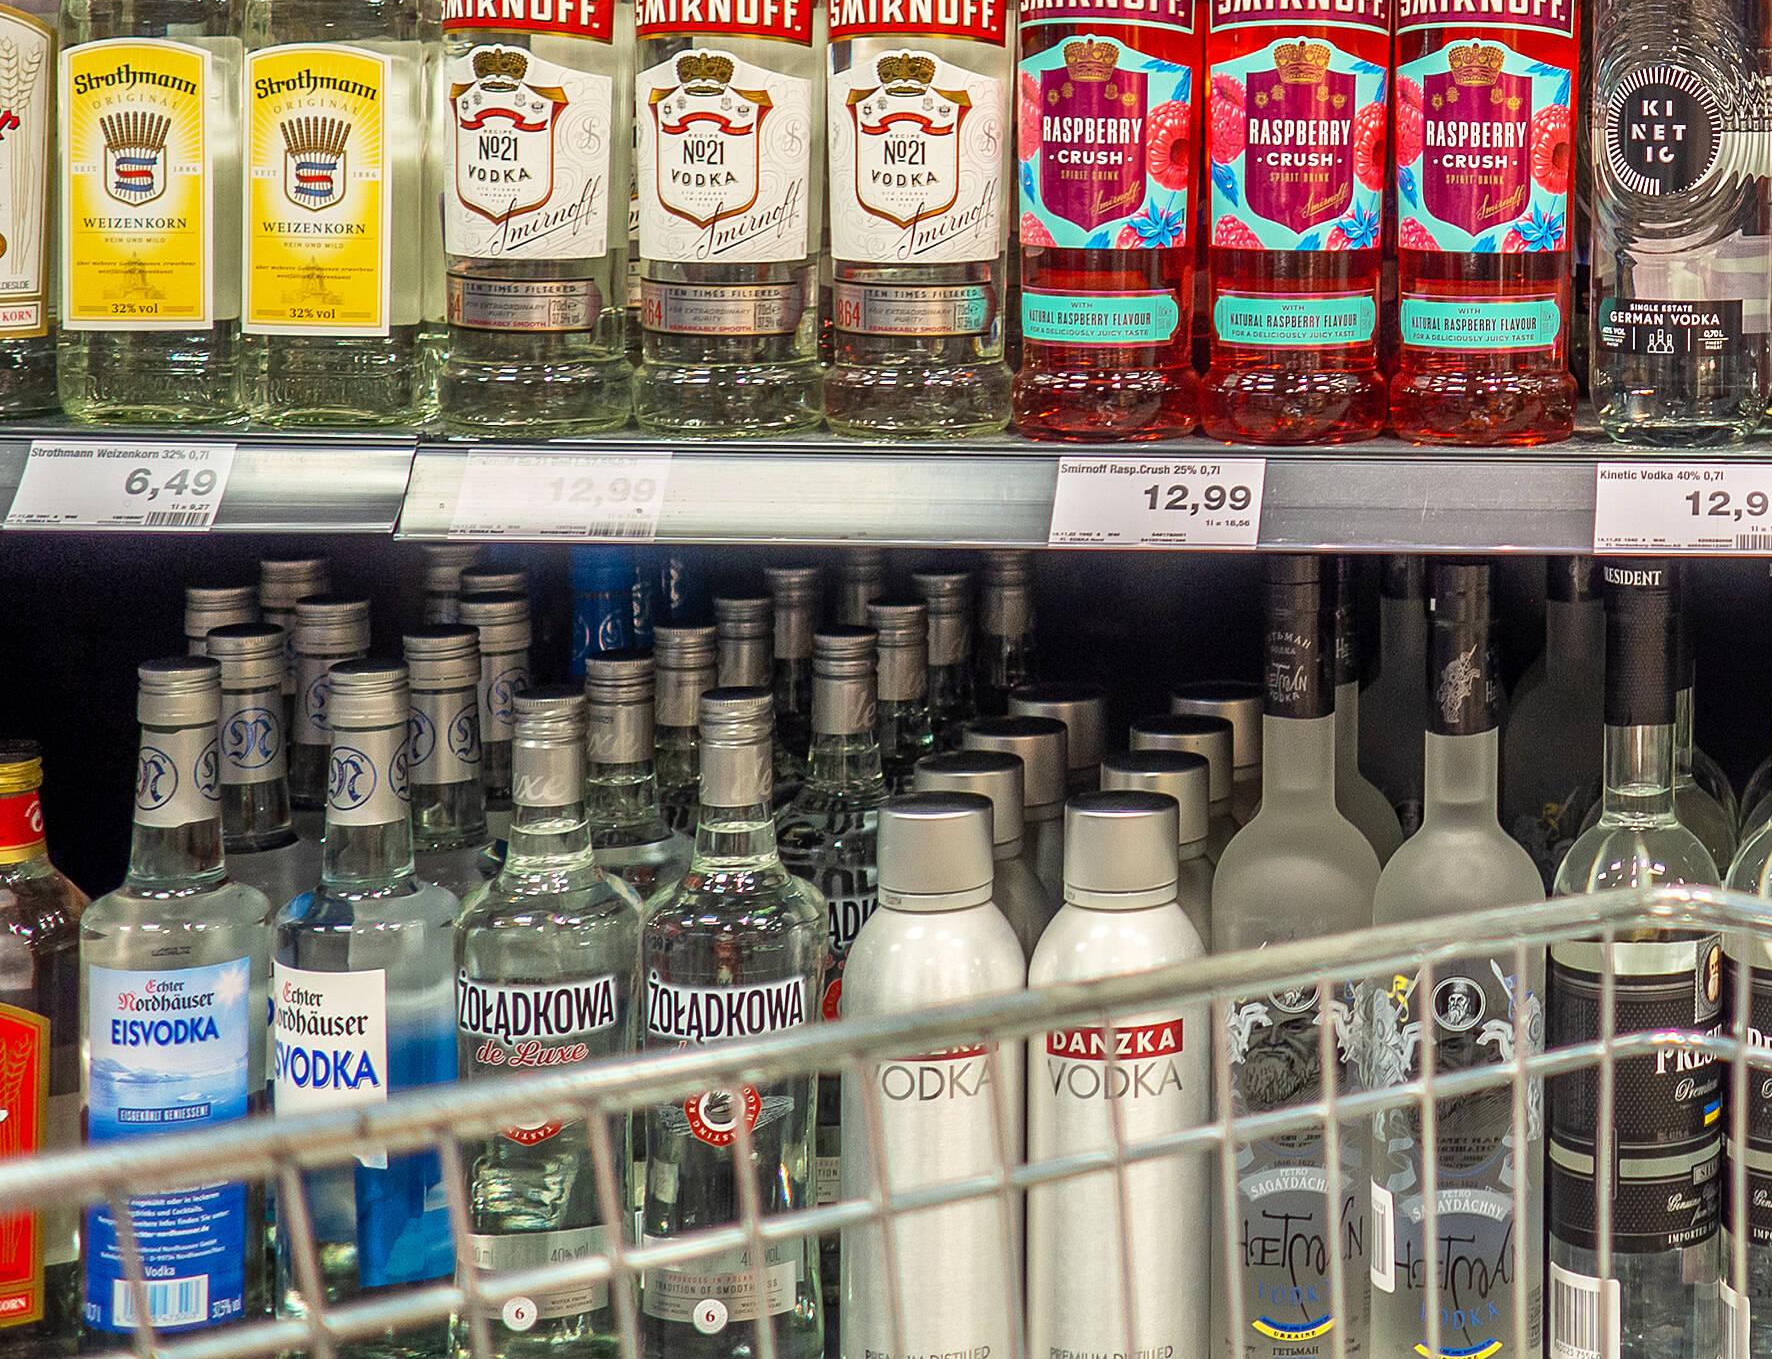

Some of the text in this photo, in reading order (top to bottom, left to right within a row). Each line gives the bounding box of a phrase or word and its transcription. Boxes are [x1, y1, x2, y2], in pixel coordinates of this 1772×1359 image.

[73, 64, 198, 97] Strothmann
[254, 68, 378, 101] Strothmann
[1042, 117, 1143, 145] RASPBERRY
[1249, 118, 1351, 146] RASPBERRY
[1056, 149, 1125, 166] CRUSH
[1266, 151, 1334, 168] CRUSH
[671, 168, 740, 188] VODKA
[870, 169, 939, 188] VODKA
[83, 217, 188, 230] WEIZENKORN
[262, 220, 367, 235] WEIZENKORN
[110, 302, 159, 315] 32% vol
[1281, 304, 1306, 312] WITH
[1609, 311, 1721, 326] GERMAN VODKA
[1230, 313, 1357, 330] NATURAL RASPBERRY FLAVOUR
[1060, 463, 1108, 475] Smirnoff
[1110, 464, 1171, 476] Rasp.Crush
[1174, 465, 1197, 476] 25%
[124, 466, 218, 502] 6,49
[547, 476, 658, 508] 12,99
[1142, 484, 1252, 516] 12,99
[144, 979, 185, 995] Echter
[118, 988, 214, 1013] Nordhäuser
[458, 971, 615, 1045] ŻOŁĄDKOWA
[648, 970, 805, 1039] ŻOŁĄDKOWA
[110, 1016, 220, 1048] EISVODKA
[475, 1040, 589, 1068] de Luxe
[1047, 1058, 1184, 1100] VODKA
